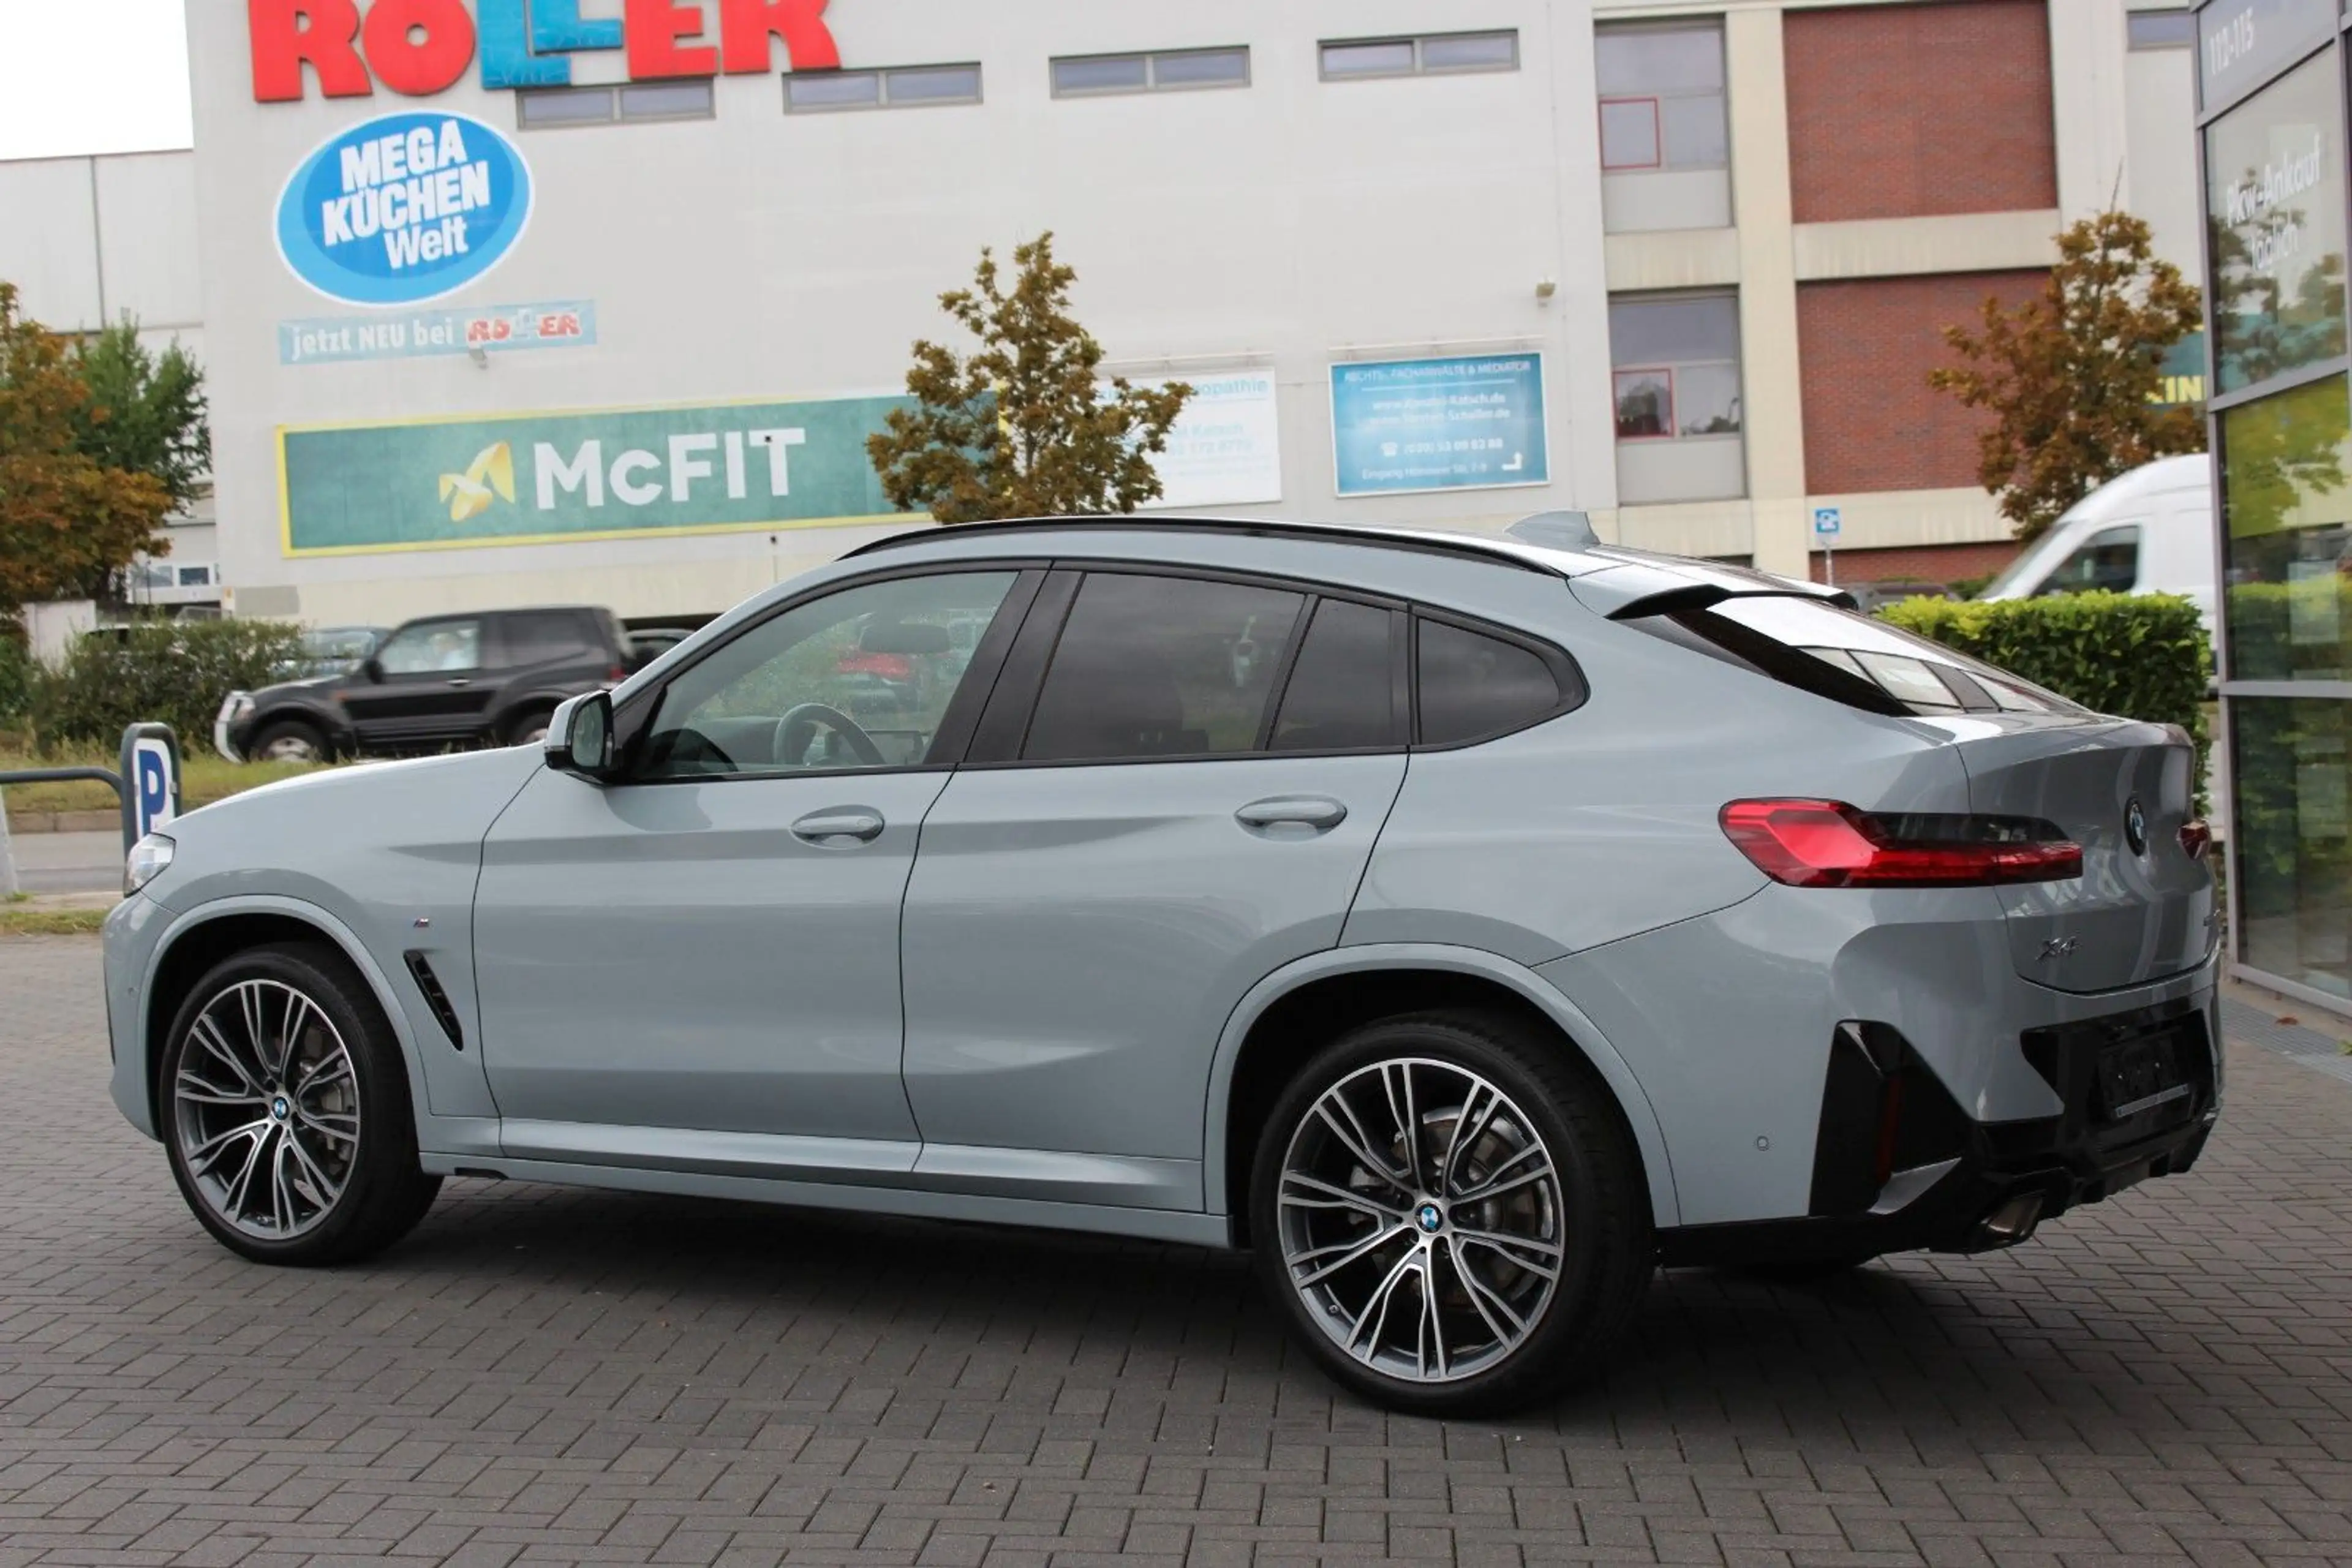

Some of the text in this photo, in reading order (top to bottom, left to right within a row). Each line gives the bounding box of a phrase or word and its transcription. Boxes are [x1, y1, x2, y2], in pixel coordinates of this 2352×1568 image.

[340, 118, 468, 193] MEGA
[2227, 132, 2321, 229] Pkw-Ankauf
[322, 160, 490, 247] KÜCHEN
[383, 216, 469, 270] Welt
[291, 326, 350, 361] jetzt
[358, 320, 404, 350] NEU
[412, 317, 453, 347] bei
[533, 428, 805, 510] McFIT
[138, 749, 166, 837] P
